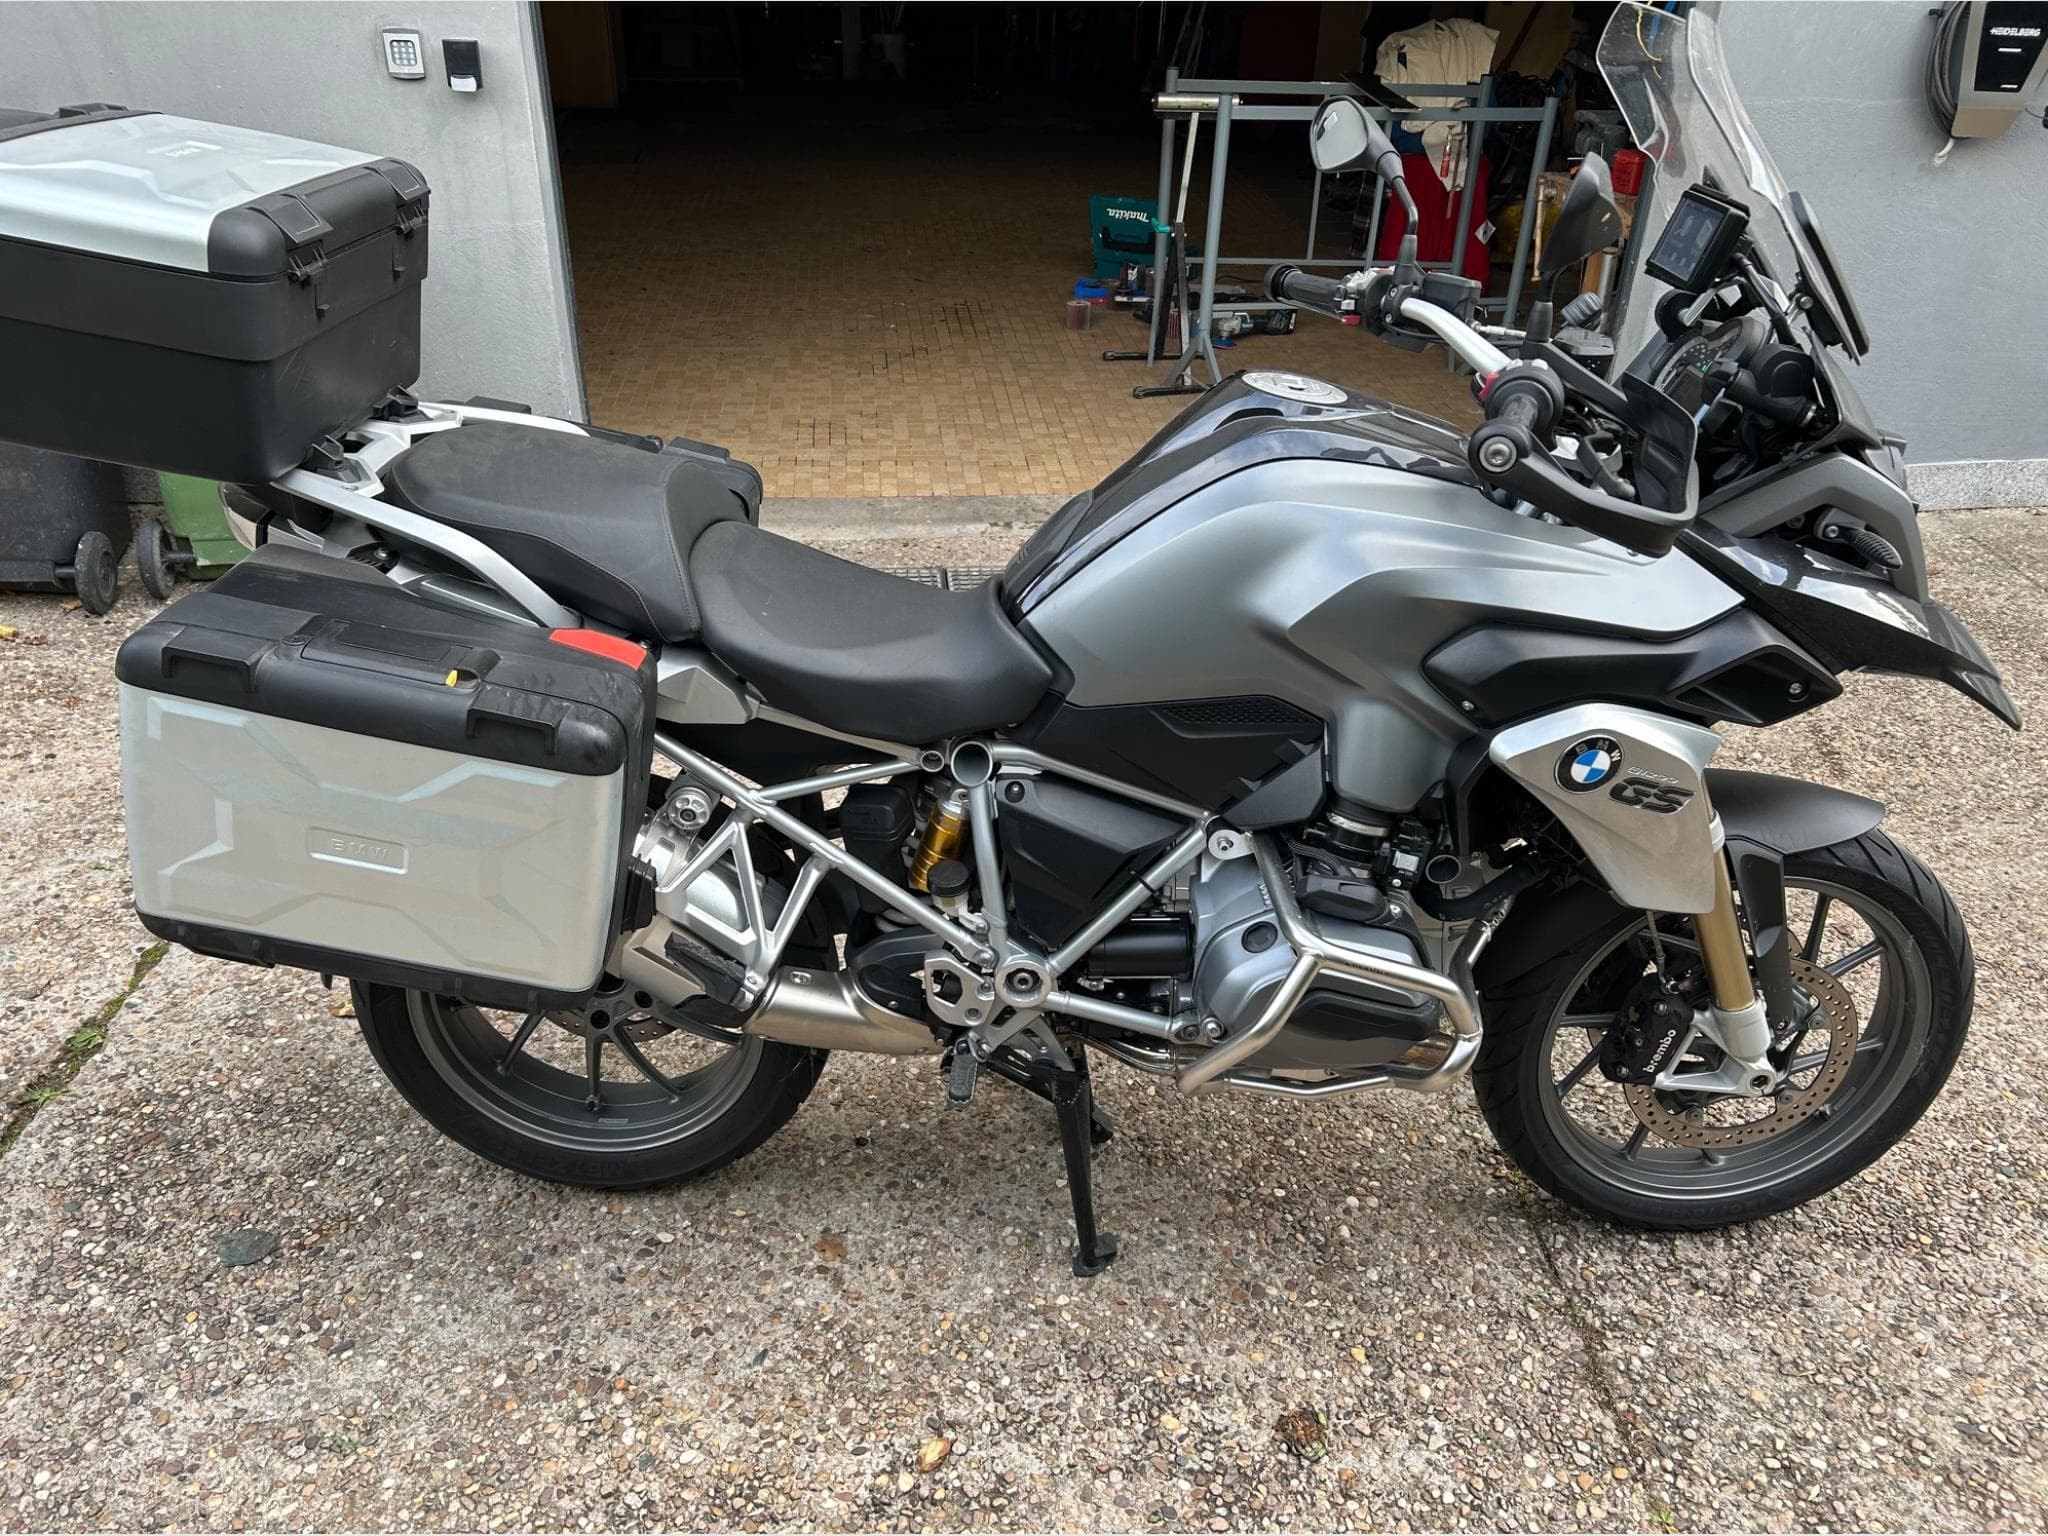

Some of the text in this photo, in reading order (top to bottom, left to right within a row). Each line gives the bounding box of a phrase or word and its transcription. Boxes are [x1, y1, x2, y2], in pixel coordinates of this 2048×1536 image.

[1106, 207, 1149, 222] makita
[1575, 739, 1622, 762] BMW
[1608, 777, 1697, 814] GS
[330, 838, 389, 857] BMW
[1642, 1029, 1677, 1073] brembo
